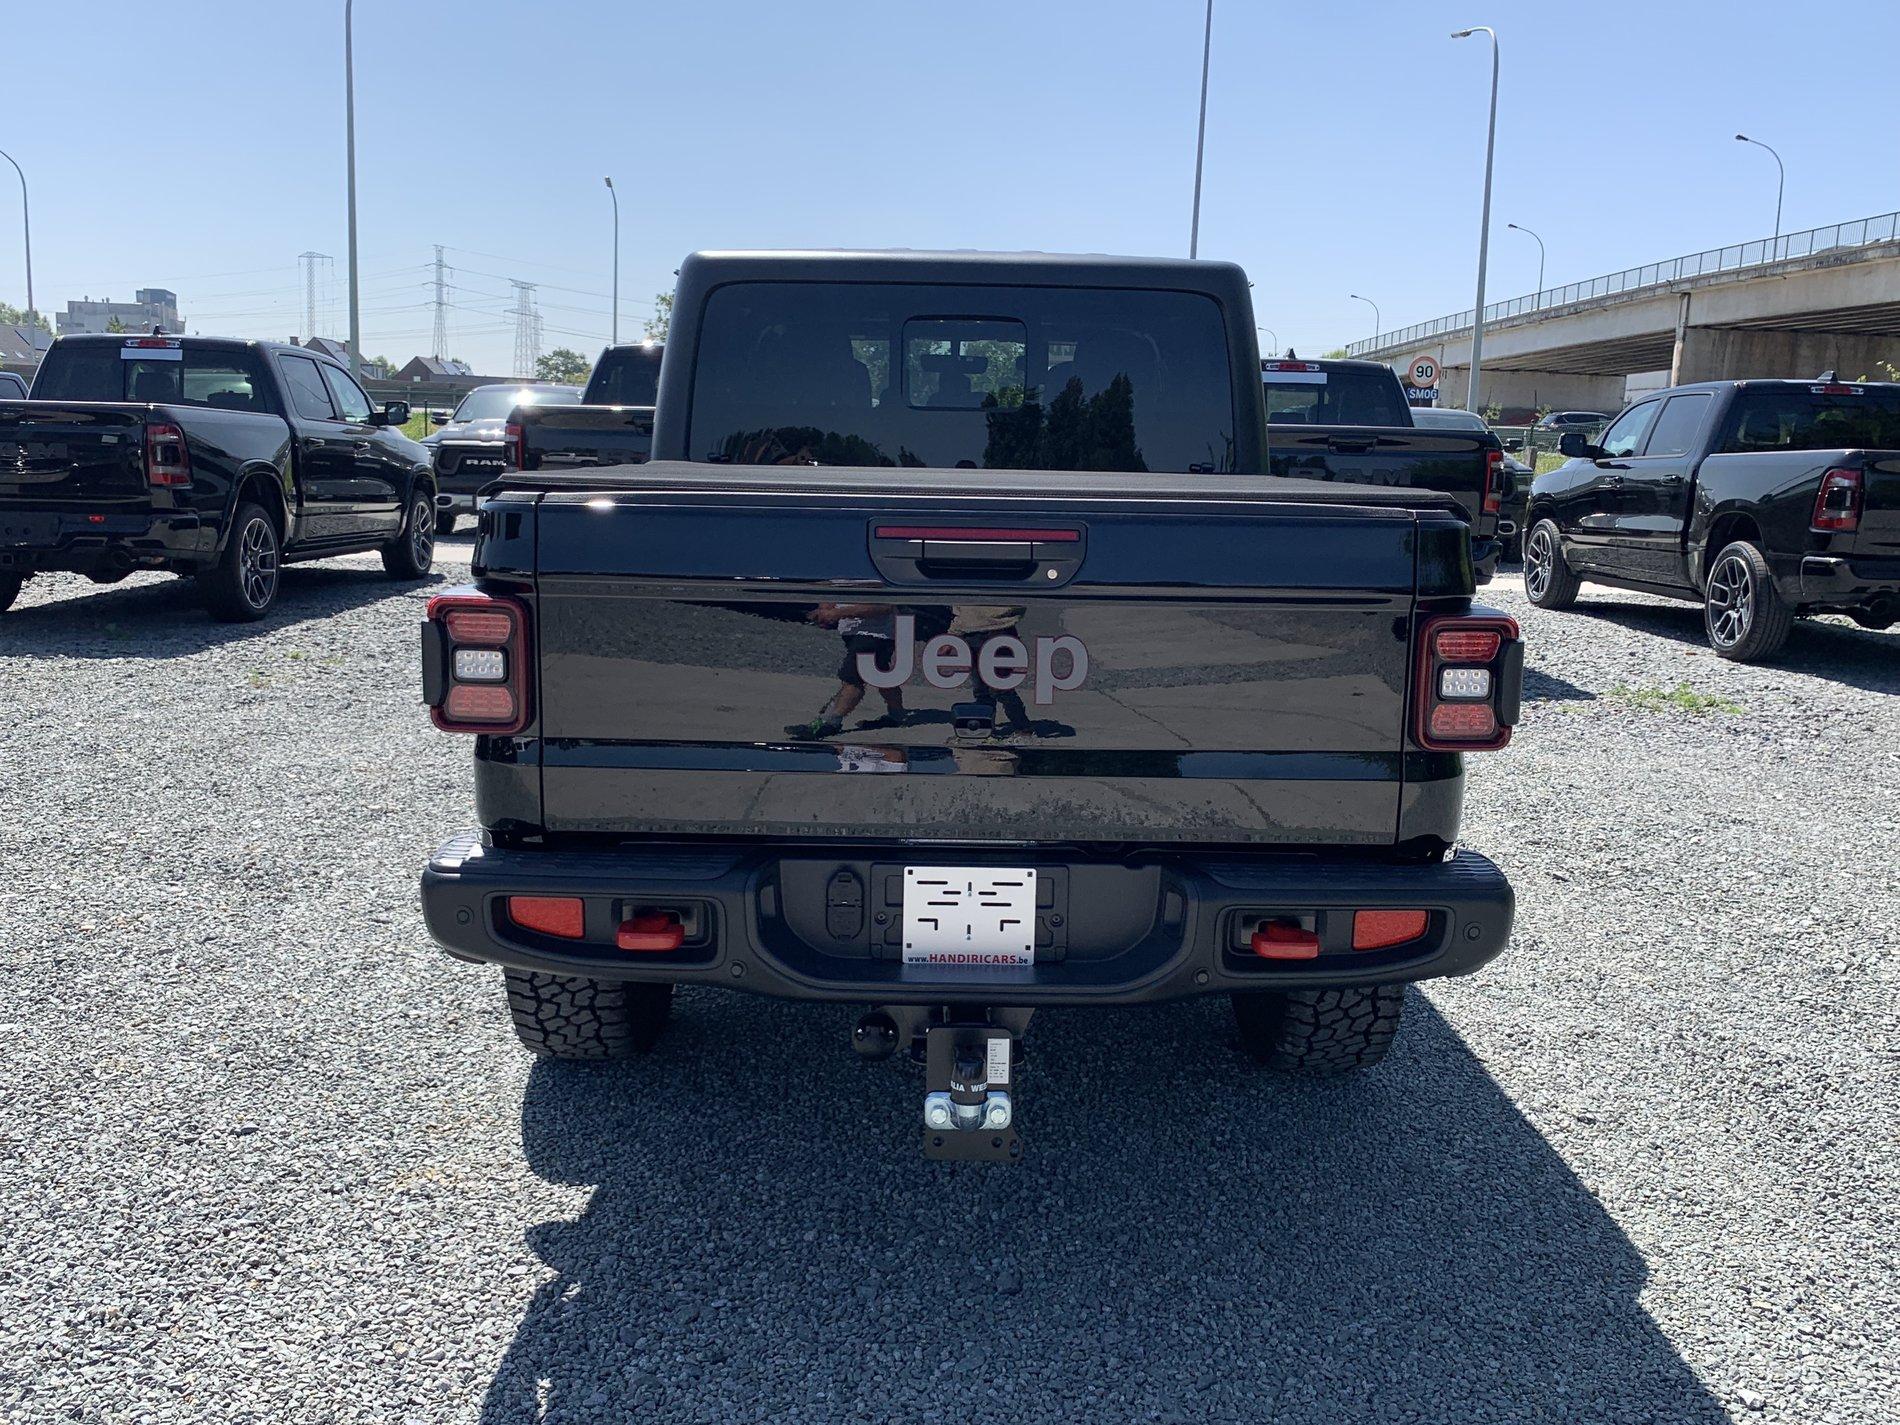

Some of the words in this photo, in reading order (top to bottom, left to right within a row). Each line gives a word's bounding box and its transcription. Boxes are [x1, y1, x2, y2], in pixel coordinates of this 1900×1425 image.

[1416, 366, 1434, 378] 90
[1409, 389, 1438, 399] SMOG
[856, 615, 1089, 705] Jeep
[907, 954, 1029, 964] www.HANDIRICARS.be
